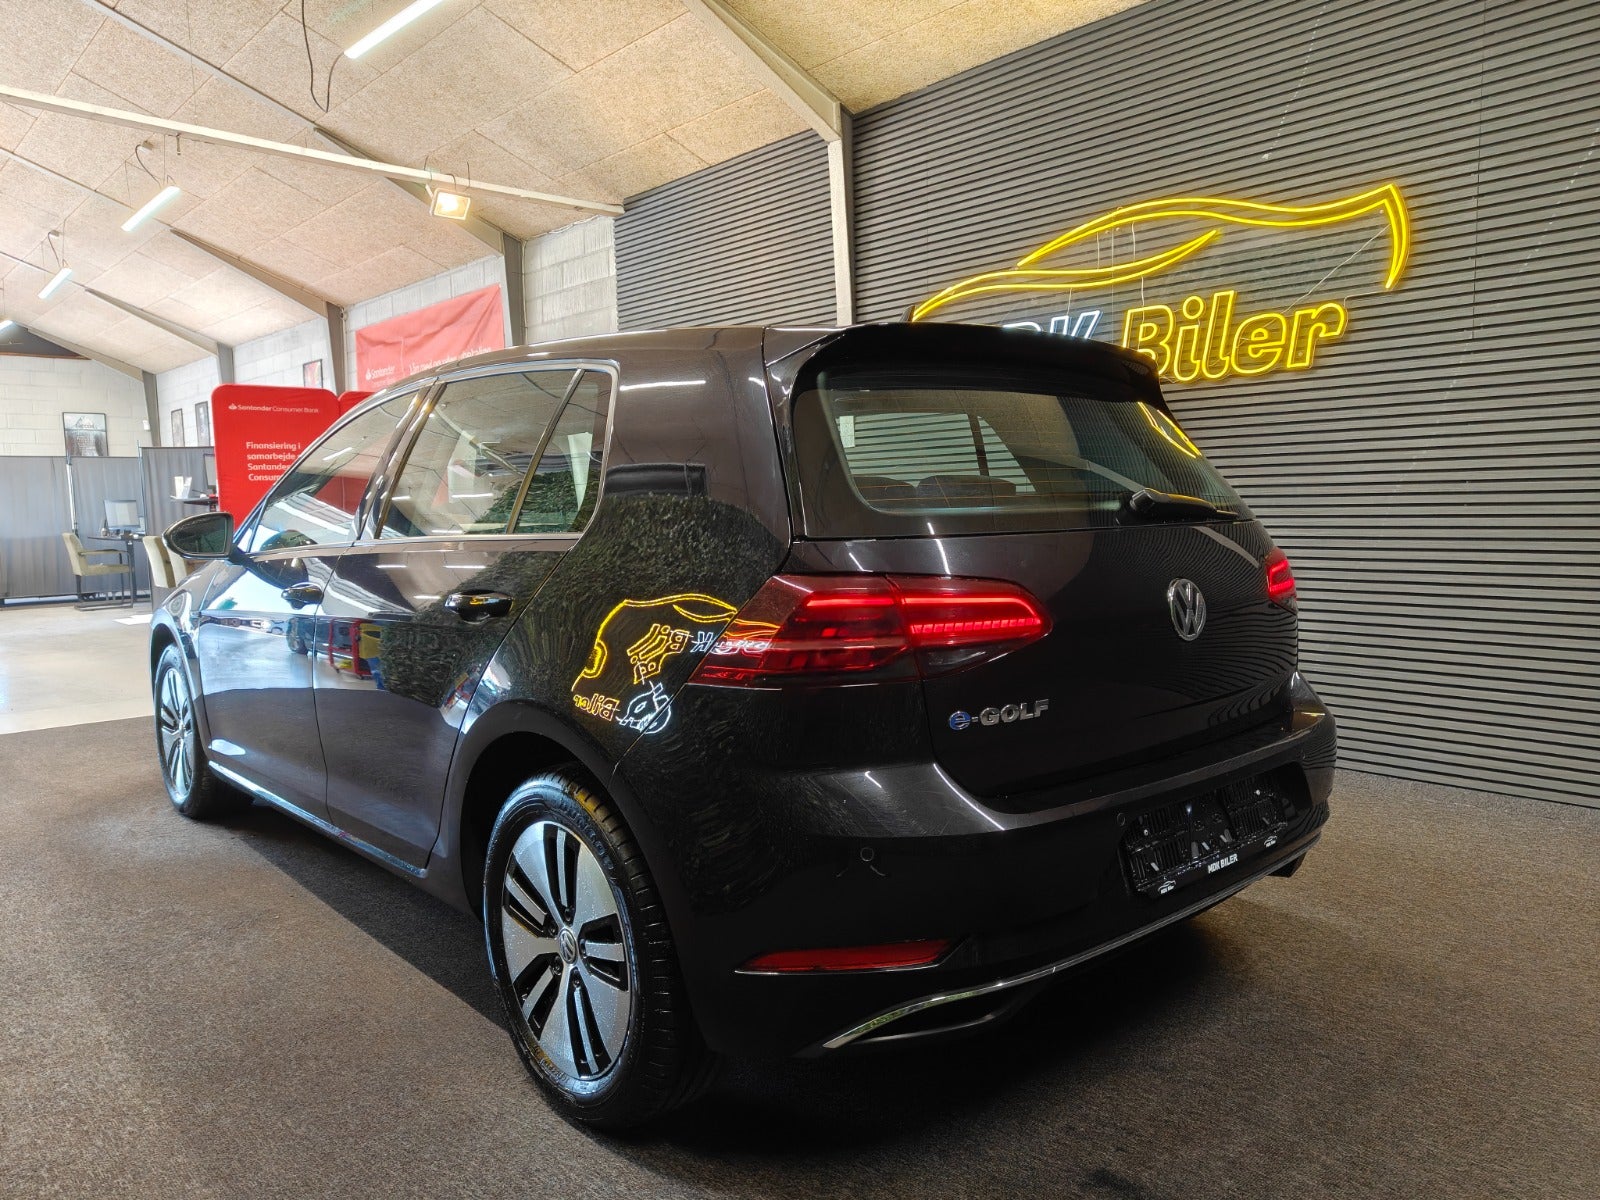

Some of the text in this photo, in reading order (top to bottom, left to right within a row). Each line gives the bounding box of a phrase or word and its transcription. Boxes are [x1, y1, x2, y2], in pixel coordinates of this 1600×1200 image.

[1122, 289, 1347, 382] Biler
[237, 404, 272, 412] Santander
[246, 441, 301, 451] Finansiering i
[247, 452, 296, 462] samarbejde
[948, 698, 1049, 731] e-GOLF
[1207, 853, 1239, 874] MDK BILER
